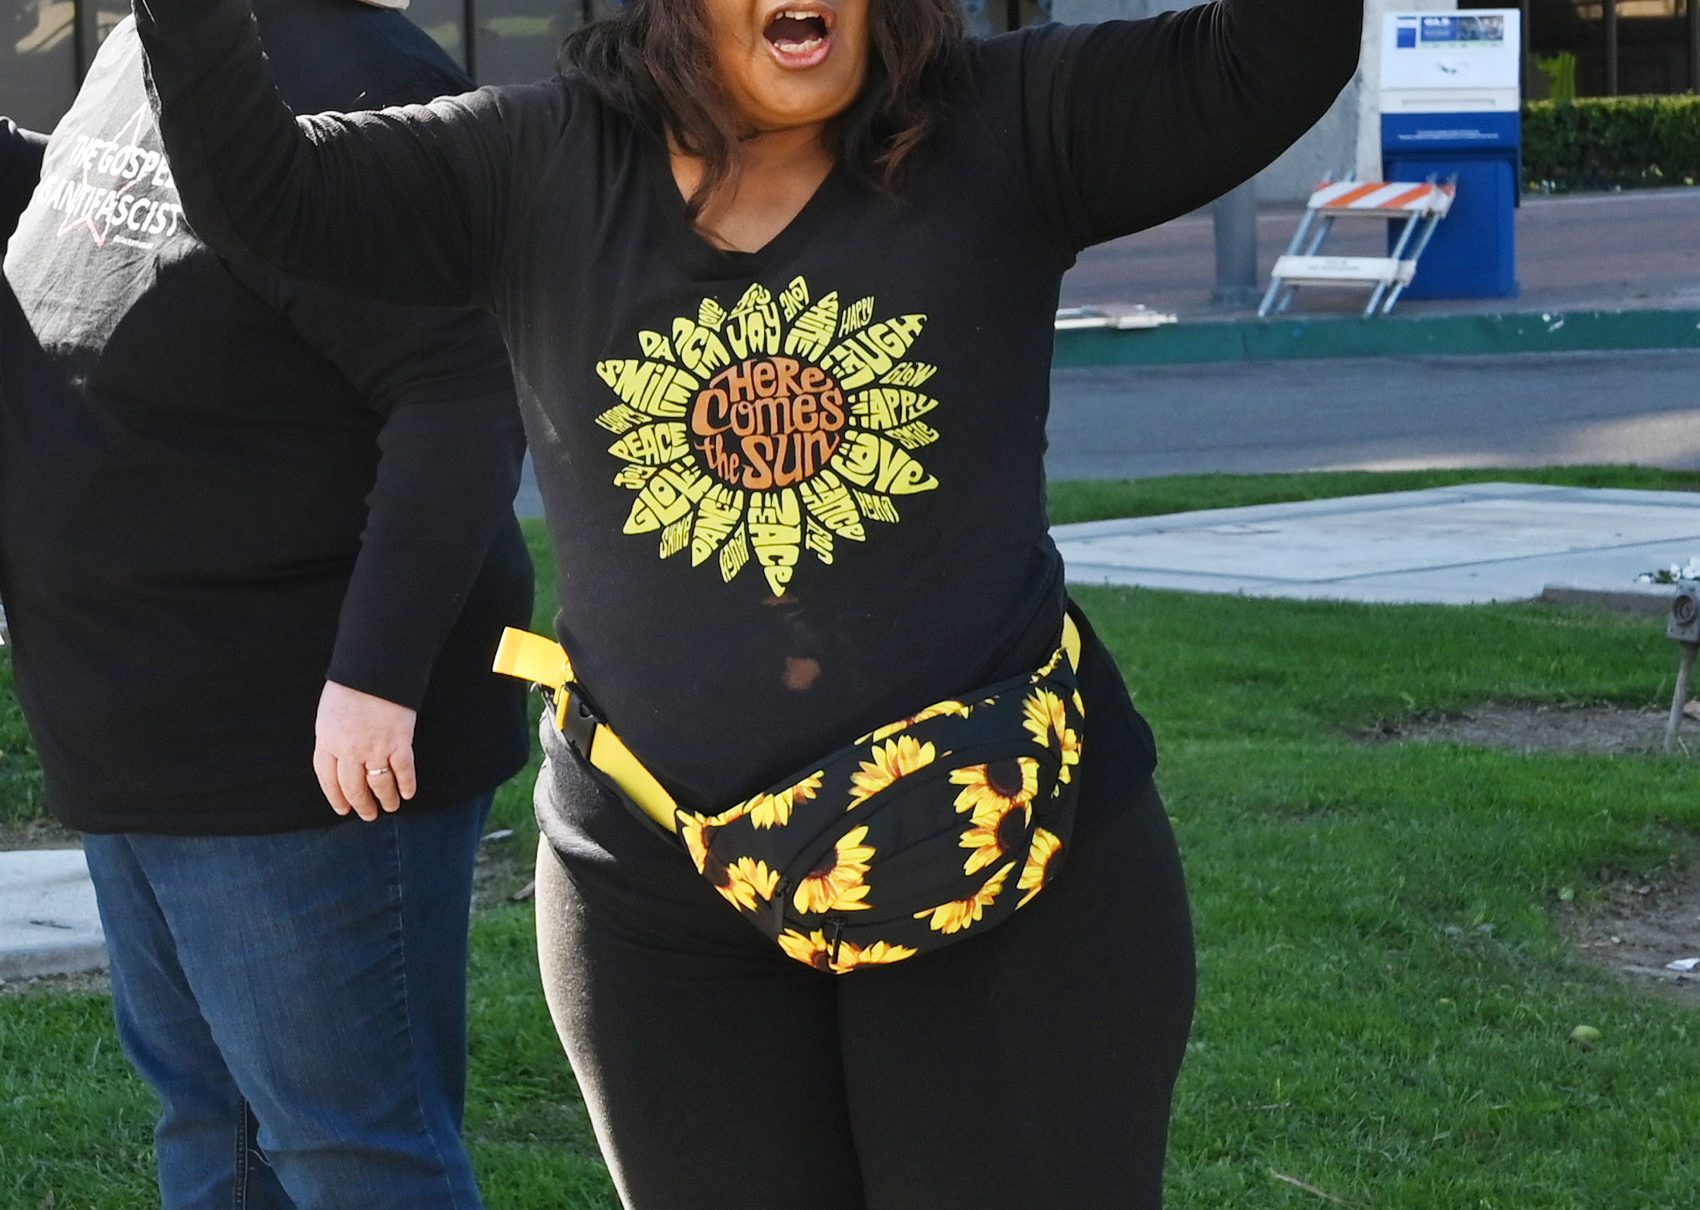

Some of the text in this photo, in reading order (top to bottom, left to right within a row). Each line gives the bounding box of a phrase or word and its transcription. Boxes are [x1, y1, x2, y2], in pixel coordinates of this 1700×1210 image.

[53, 177, 184, 237] ANTIFASCIST
[608, 422, 690, 465] PEACE
[693, 433, 741, 485] the
